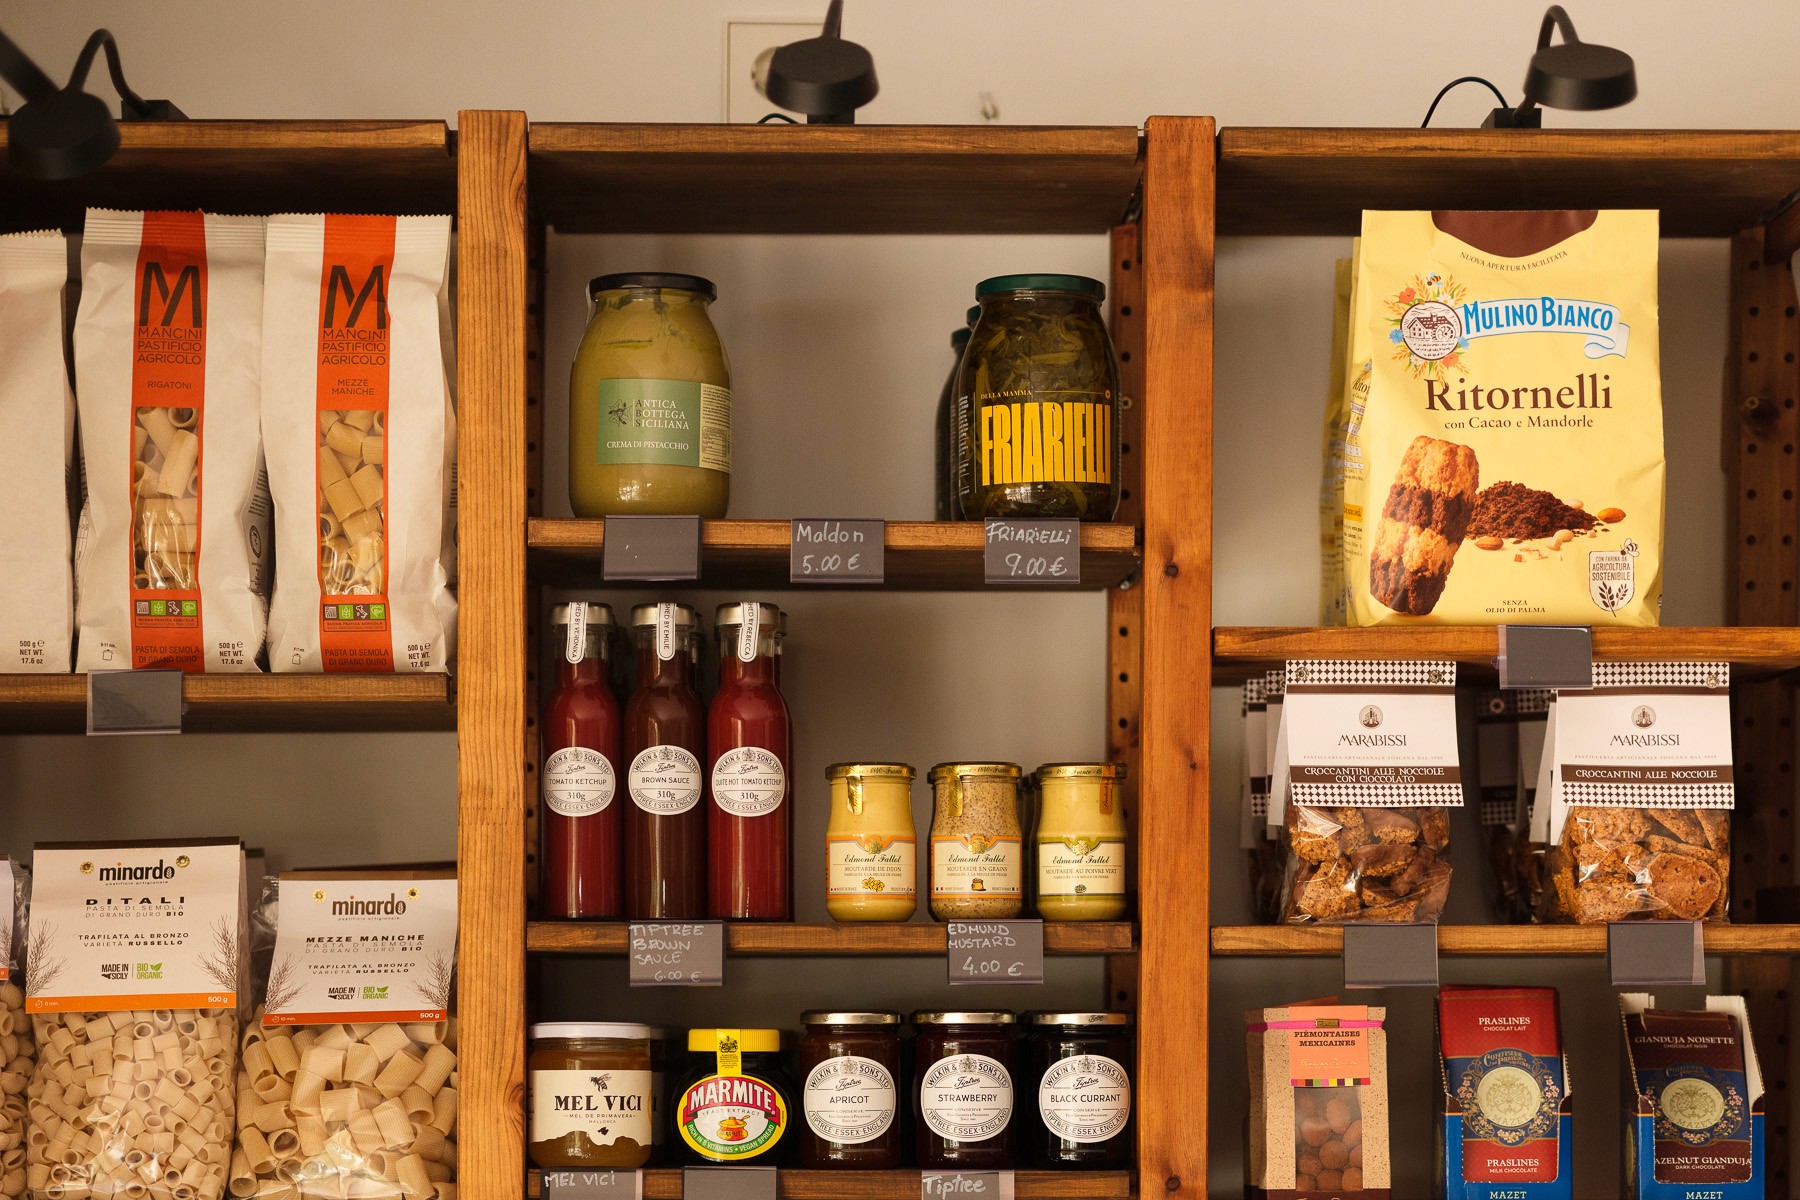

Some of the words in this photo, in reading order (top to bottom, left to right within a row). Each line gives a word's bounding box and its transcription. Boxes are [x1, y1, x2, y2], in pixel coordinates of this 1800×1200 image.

[136, 261, 203, 328] M
[323, 264, 386, 329] M
[1462, 301, 1538, 335] MULINO
[1541, 297, 1613, 331] BIANCO
[138, 327, 202, 339] MANCINI
[322, 329, 386, 340] MANCINI
[137, 340, 202, 351] PASTIFICIO
[322, 341, 386, 352] PASTIFICIO
[137, 353, 202, 365] AGRICOLO
[322, 355, 386, 366] AGRICOLO
[147, 380, 192, 390] RIGATONI
[337, 379, 369, 387] MEZZE
[331, 387, 375, 396] MANICHE
[1425, 373, 1613, 412] Ritornelli
[635, 399, 677, 410] ANTICA
[635, 409, 687, 420] BOTTEGA
[635, 418, 690, 430] SICILIANA
[1444, 420, 1466, 429] con
[1469, 417, 1511, 428] Cacao
[1527, 416, 1593, 428] Mandorle
[981, 402, 1111, 486] FRIARIELLI
[797, 523, 864, 544] Maldon
[802, 552, 841, 574] 5.00
[847, 553, 860, 570] €
[1338, 734, 1407, 748] MARABISSI
[1610, 734, 1680, 747] MARABISSI
[1304, 767, 1370, 776] CROCCANTINI
[1373, 767, 1396, 775] ALLE
[1399, 767, 1445, 775] NOCCIOLE
[1575, 769, 1641, 779] CROCCANTINI
[1671, 770, 1718, 779] NOCCIOLE
[100, 859, 175, 881] minardo
[86, 896, 186, 906] DITALI
[332, 893, 406, 916] minardo
[629, 924, 704, 938] TIPTREE
[948, 924, 1010, 935] EDMUND
[633, 938, 691, 951] BROWN
[948, 937, 1016, 949] MUSTARD
[634, 952, 682, 966] SAUCE
[963, 957, 1000, 975] 4.00
[1007, 962, 1024, 976] €
[1478, 1016, 1531, 1025] PRASLINES
[1294, 1029, 1360, 1038] PIÉMONTAISES
[1299, 1039, 1356, 1047] MEXICAINES
[689, 1079, 772, 1111] MARMITE
[829, 1095, 870, 1104] APRICOT
[937, 1093, 998, 1102] STRAWBERRY
[1050, 1094, 1077, 1102] BLACK
[1080, 1094, 1121, 1102] CURRANT
[554, 1095, 599, 1111] MEL
[604, 1094, 642, 1111] VICI
[1486, 1158, 1540, 1167] PRASLINES
[922, 1174, 985, 1200] Tiptree
[1489, 1190, 1527, 1200] MAZET
[1685, 1191, 1723, 1200] MAZET
